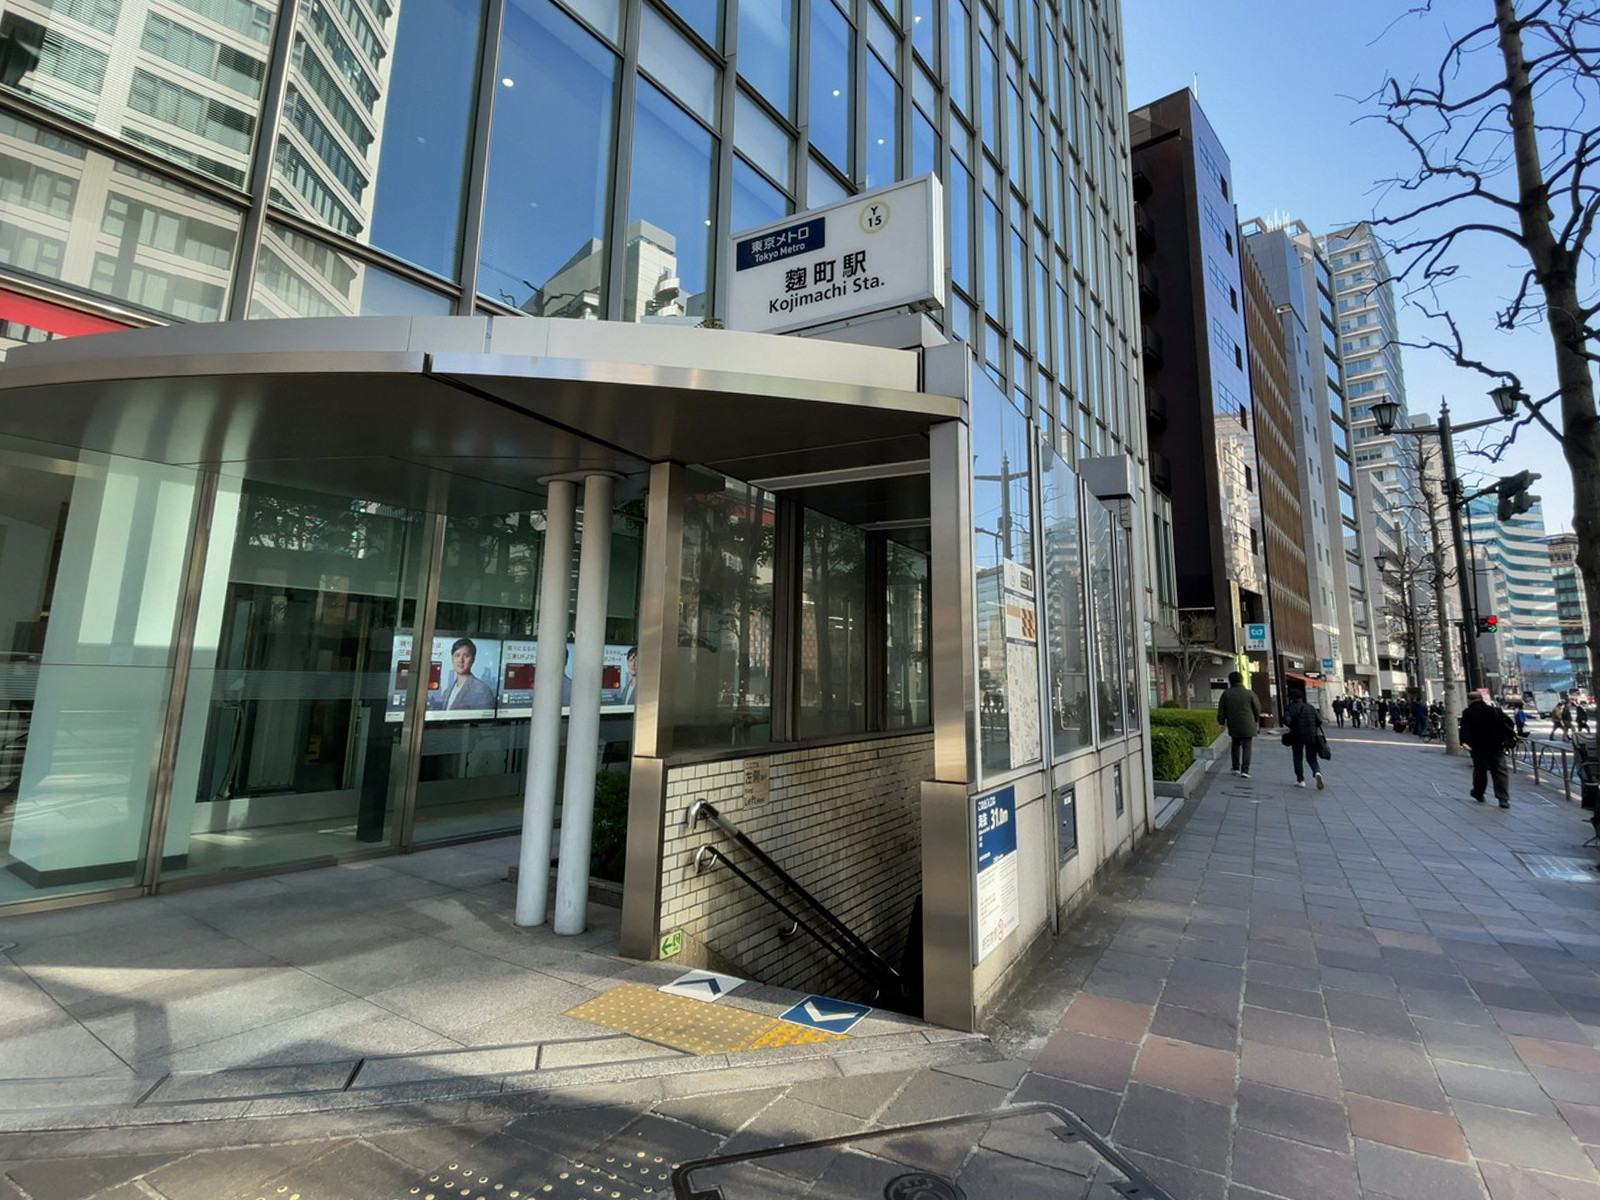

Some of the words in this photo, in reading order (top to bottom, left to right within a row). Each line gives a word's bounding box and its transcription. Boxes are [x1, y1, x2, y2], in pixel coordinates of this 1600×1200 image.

[870, 206, 879, 215] Y
[868, 215, 882, 228] 15
[751, 226, 810, 254] 東京メトロ
[755, 250, 779, 263] Tokyo
[780, 242, 806, 256] Metro
[769, 281, 847, 314] Kojimachi
[853, 275, 885, 292] Sta.
